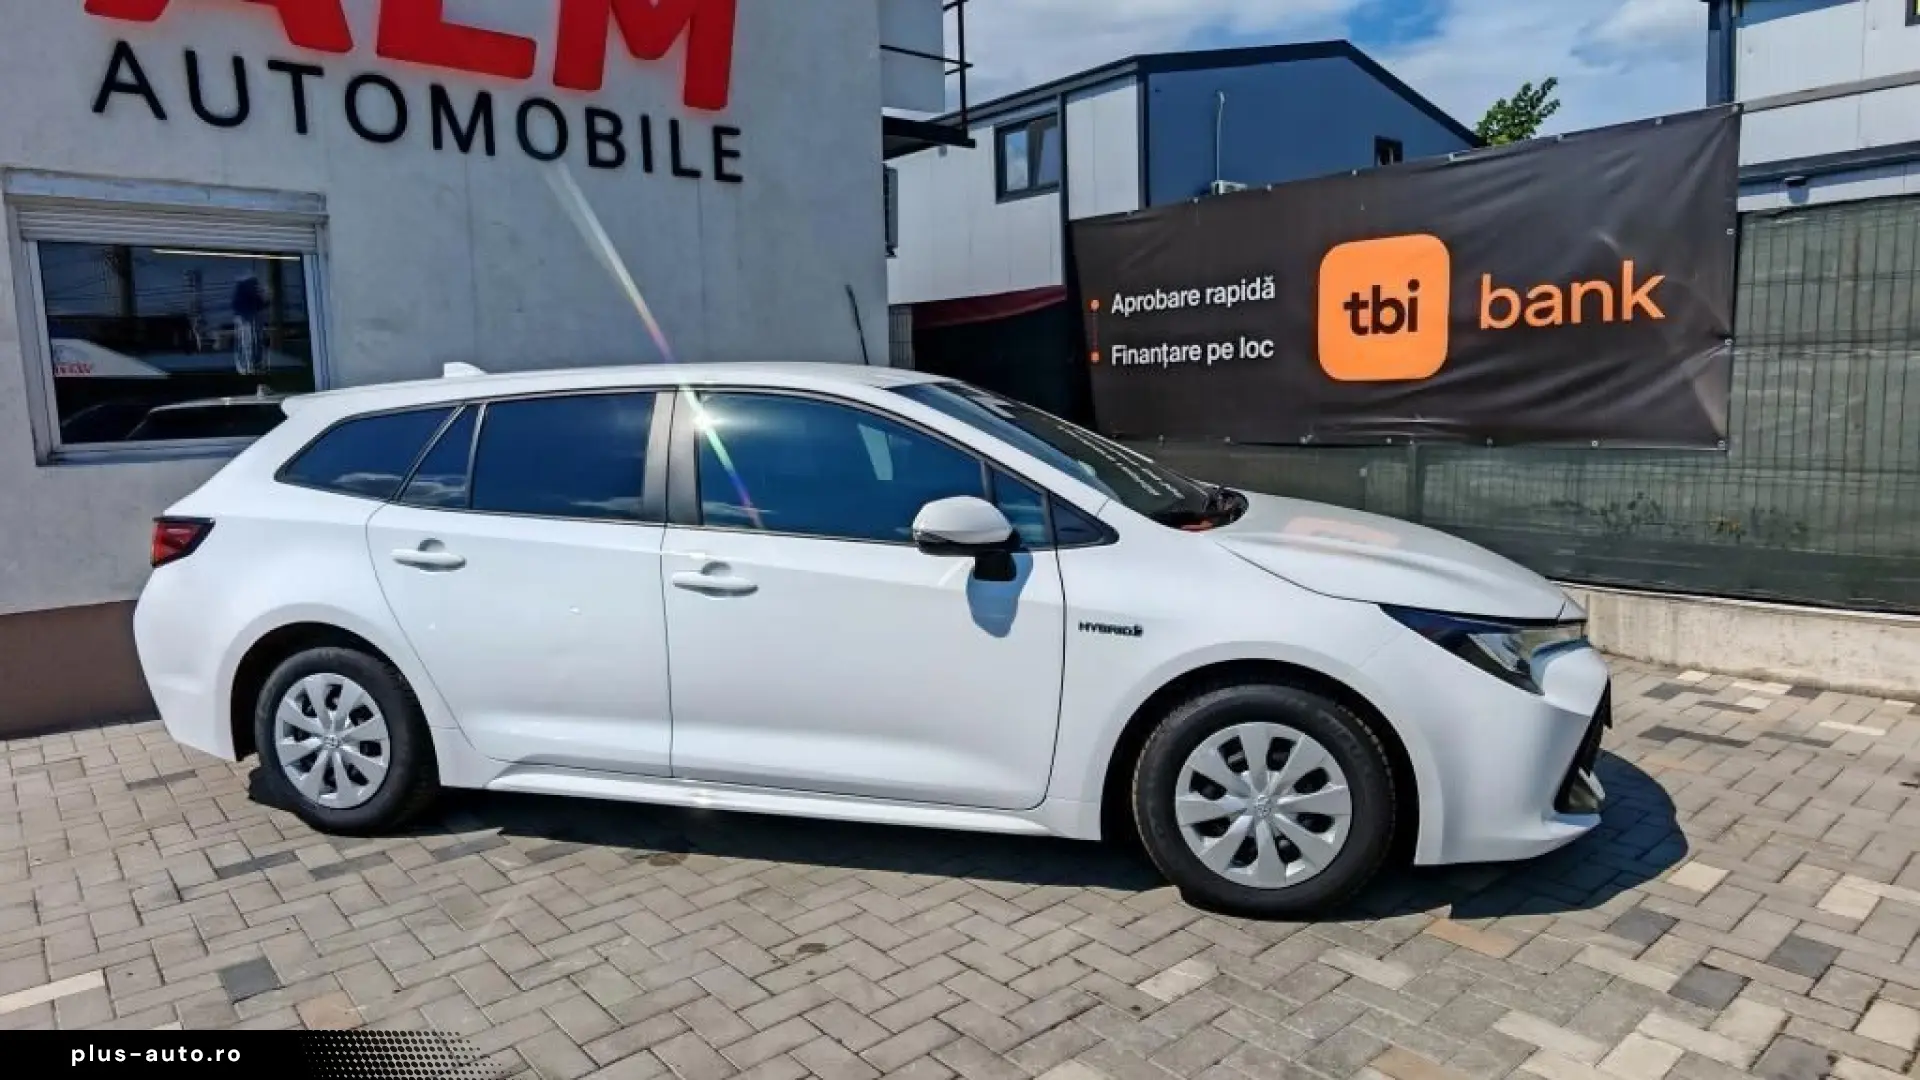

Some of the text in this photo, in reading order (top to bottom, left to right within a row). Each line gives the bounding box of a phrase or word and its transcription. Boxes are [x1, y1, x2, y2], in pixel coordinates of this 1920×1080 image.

[91, 40, 744, 184] AUTOMOBILE
[1111, 275, 1276, 317] Aprobare rapidă
[1343, 259, 1666, 336] tbi bank
[1206, 341, 1234, 365] pe
[1239, 336, 1275, 359] loc
